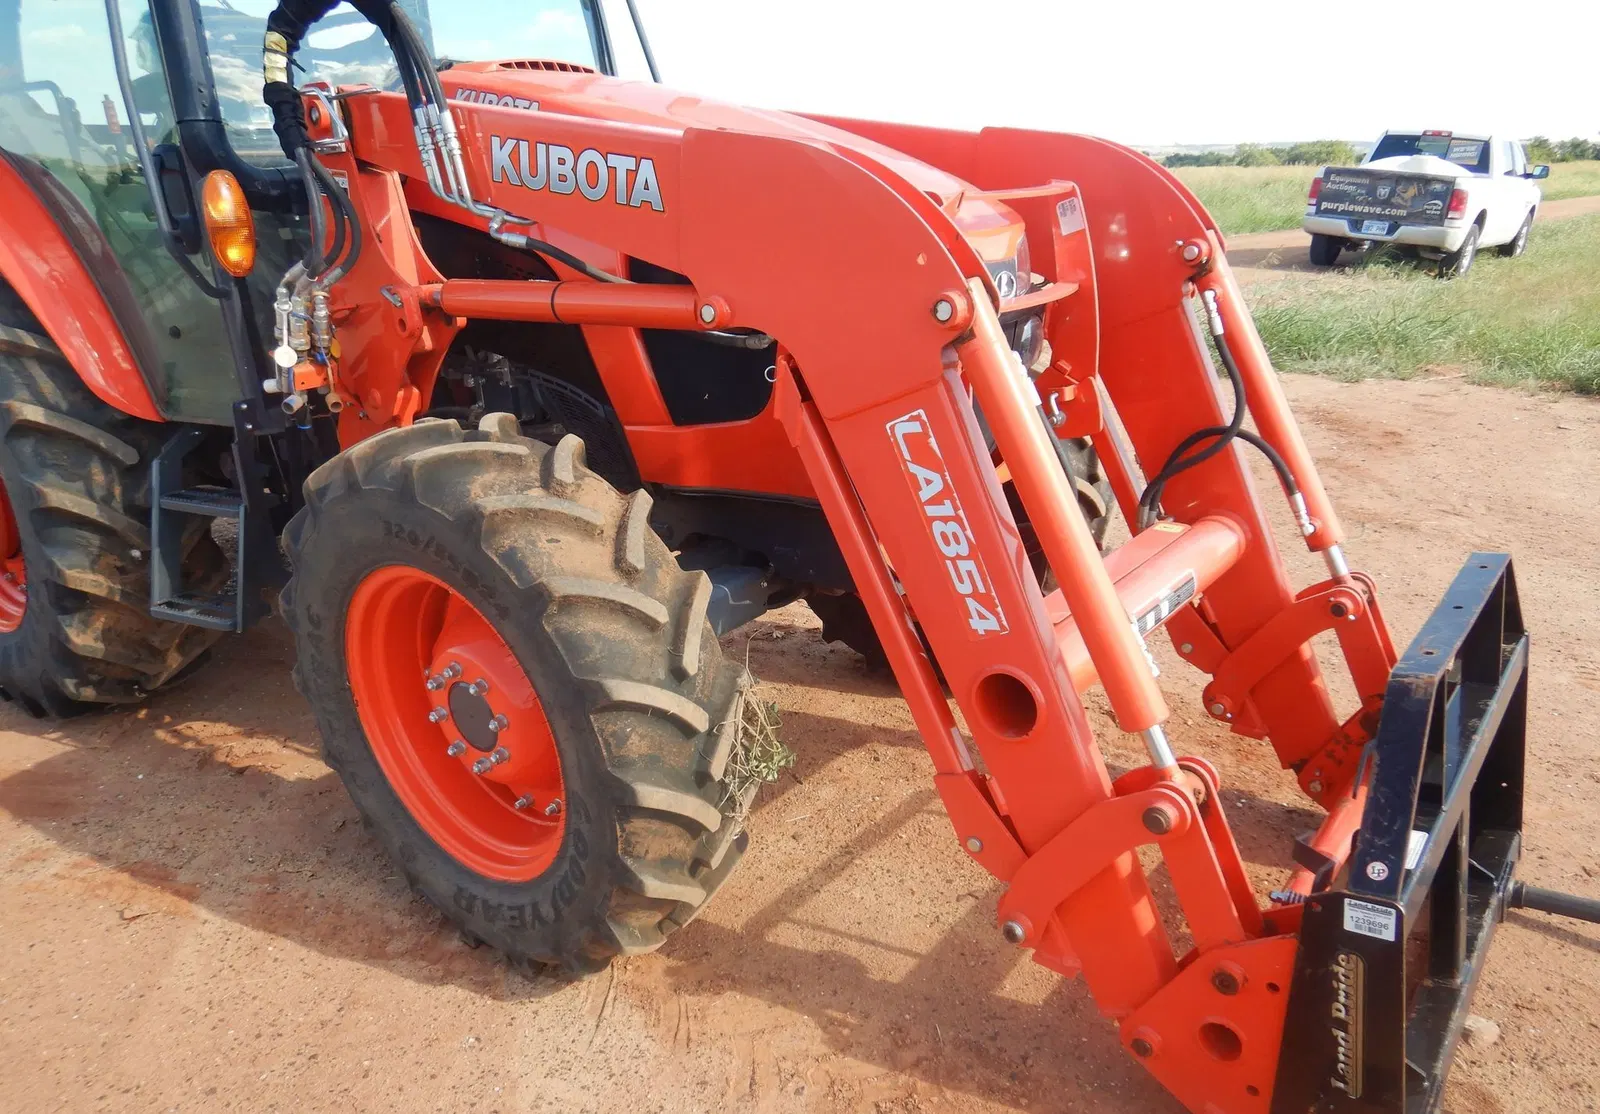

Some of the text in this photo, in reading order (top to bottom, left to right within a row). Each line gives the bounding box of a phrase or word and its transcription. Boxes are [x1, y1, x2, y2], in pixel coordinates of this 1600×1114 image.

[490, 135, 665, 212] KUBOTA
[1330, 173, 1370, 184] Equipment
[1320, 200, 1407, 217] purplewave.com
[894, 421, 1001, 635] LA1854
[1347, 900, 1369, 911] Land
[1369, 905, 1394, 917] Pride
[1350, 915, 1389, 931] 1239696
[1331, 953, 1357, 1094] Land Pride
